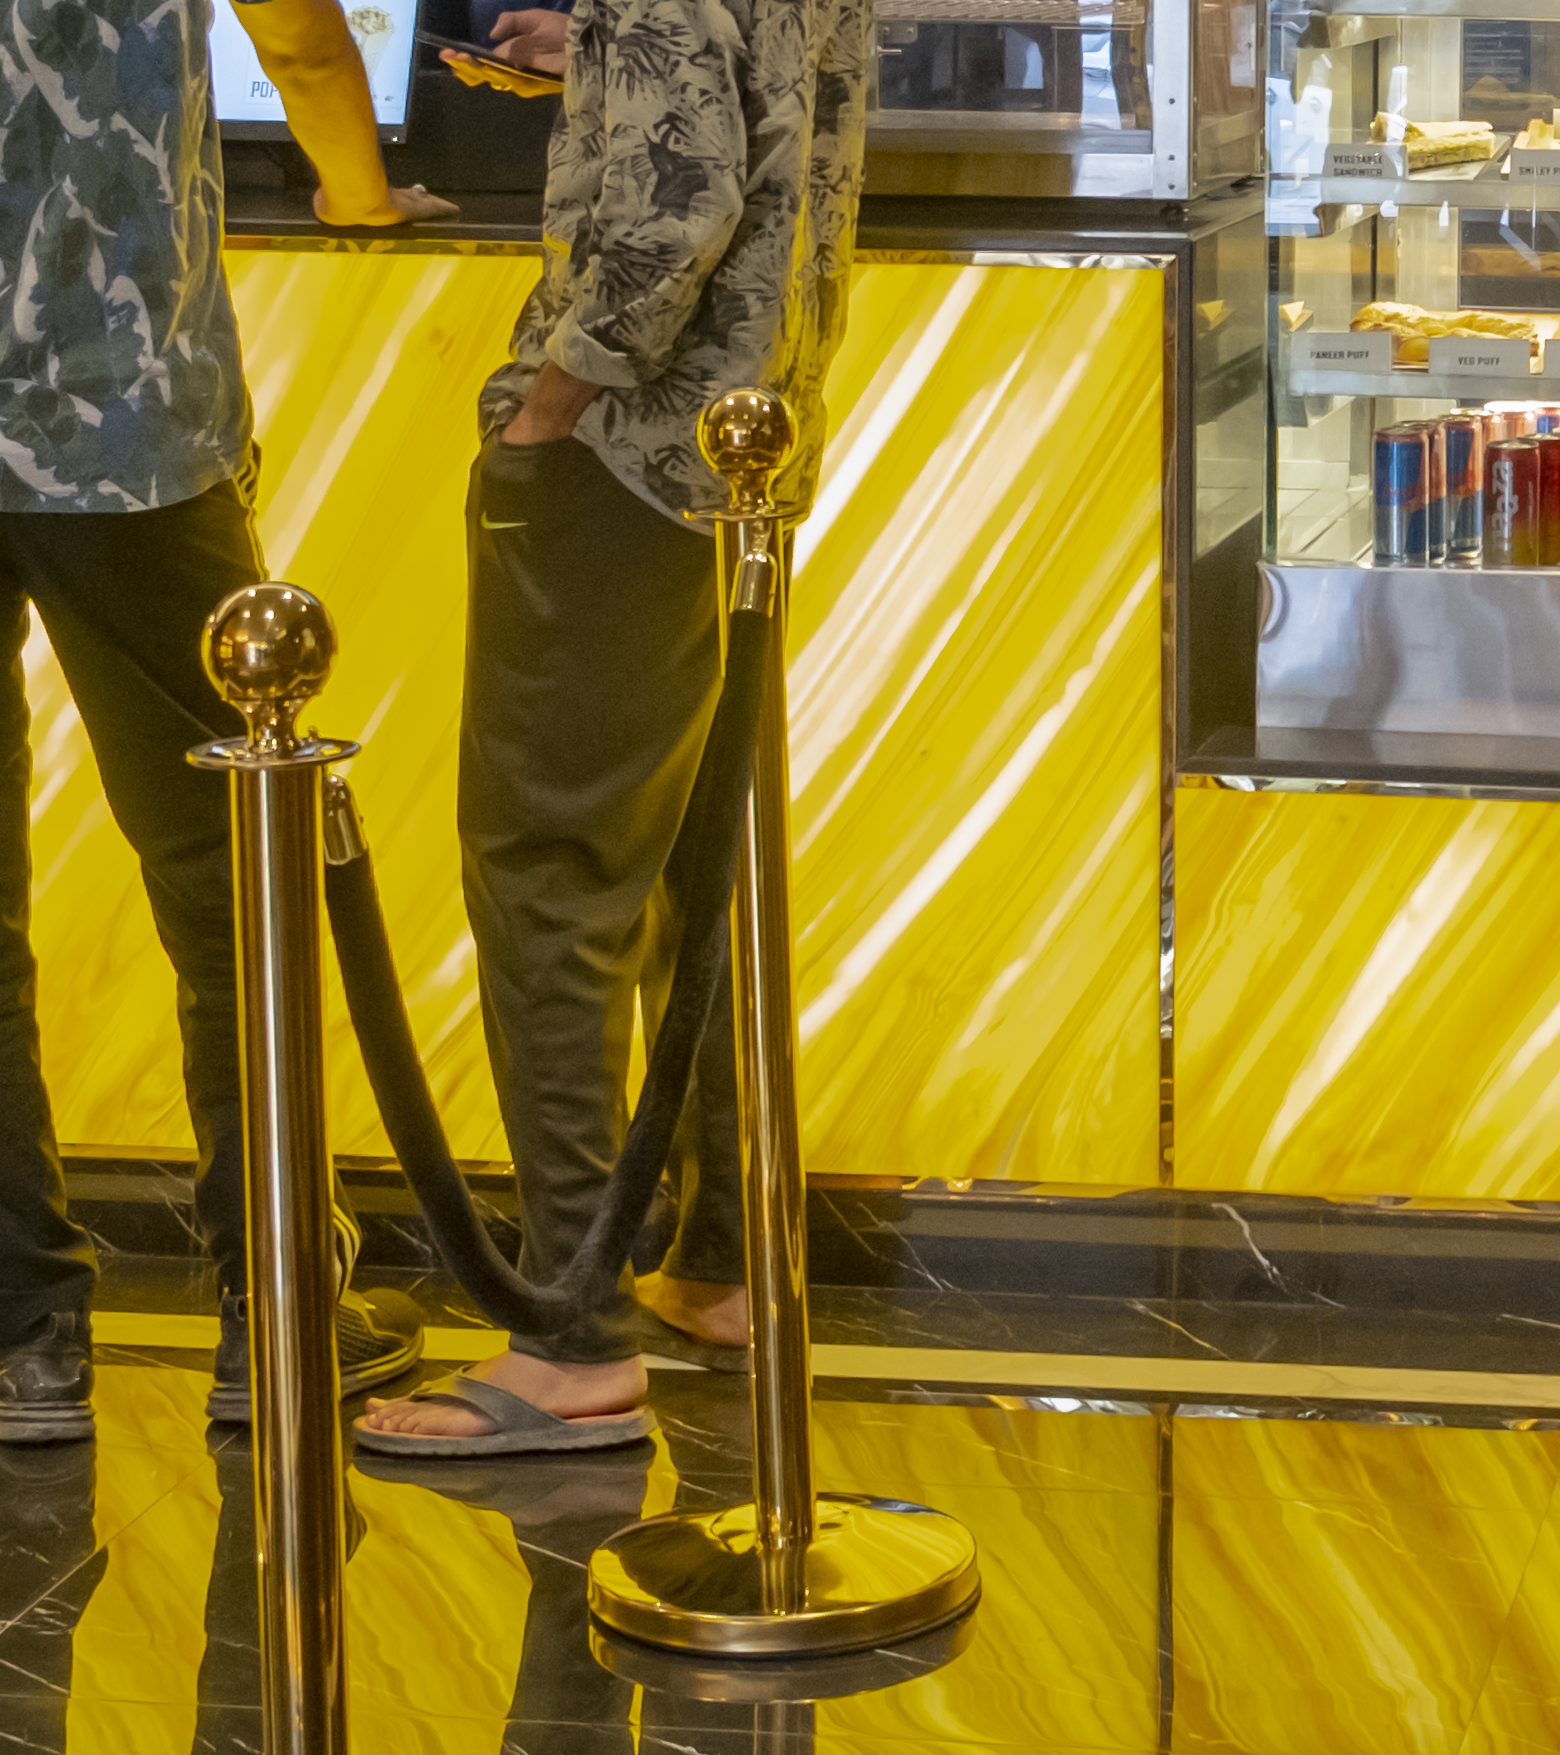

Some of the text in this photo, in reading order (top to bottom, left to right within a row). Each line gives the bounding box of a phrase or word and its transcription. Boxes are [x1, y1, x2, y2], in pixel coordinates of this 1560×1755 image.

[1333, 167, 1383, 177] SANDWICH
[1347, 350, 1370, 360] PUFF
[1477, 356, 1501, 366] PUFF
